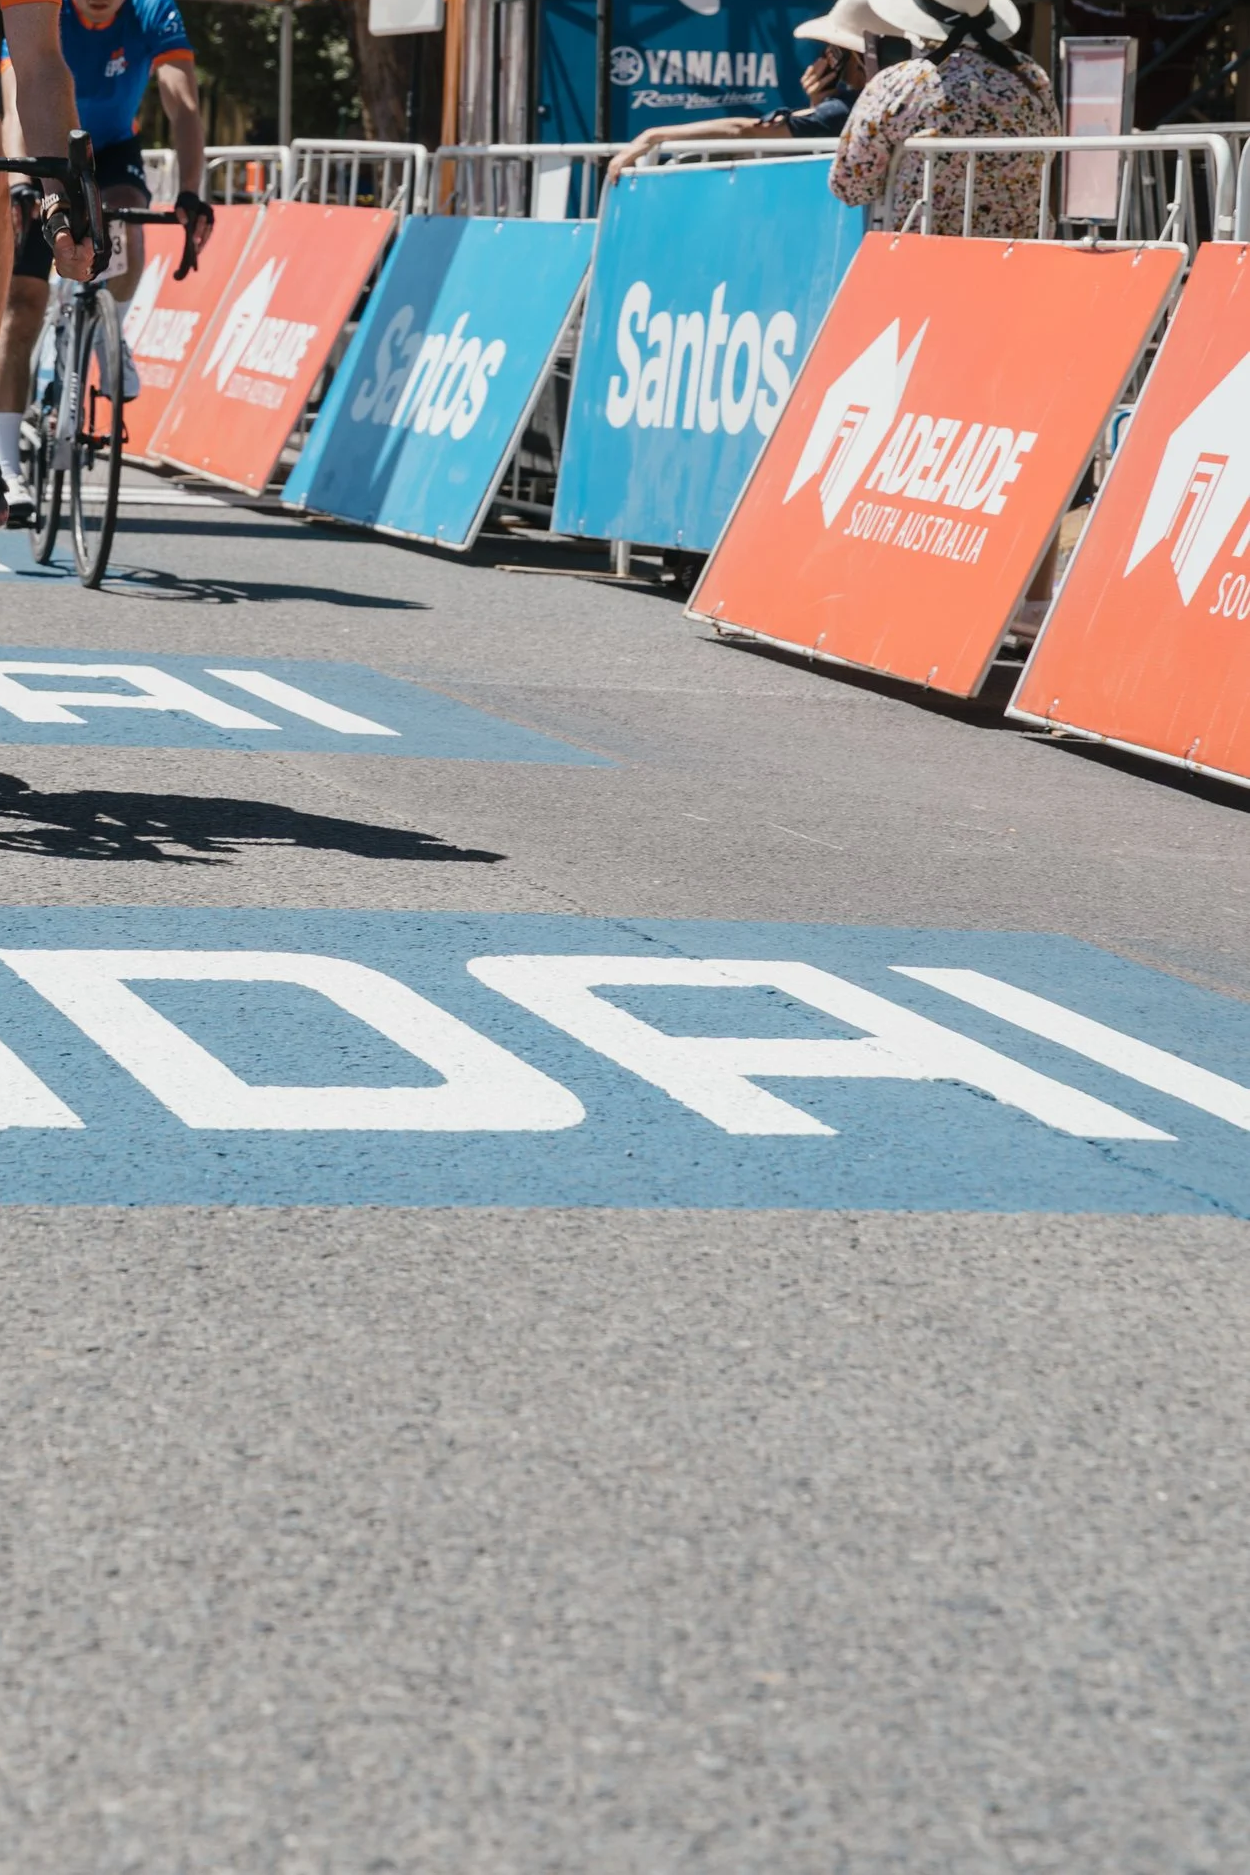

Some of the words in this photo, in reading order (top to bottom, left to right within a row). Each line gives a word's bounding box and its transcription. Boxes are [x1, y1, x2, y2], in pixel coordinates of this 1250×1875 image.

[645, 50, 779, 88] YAMAHA
[351, 304, 507, 441] Santos
[605, 280, 797, 436] Santos
[864, 412, 1039, 516] ADELAIDE
[843, 500, 902, 544] SOUTH
[892, 511, 989, 565] AUSTRALIA
